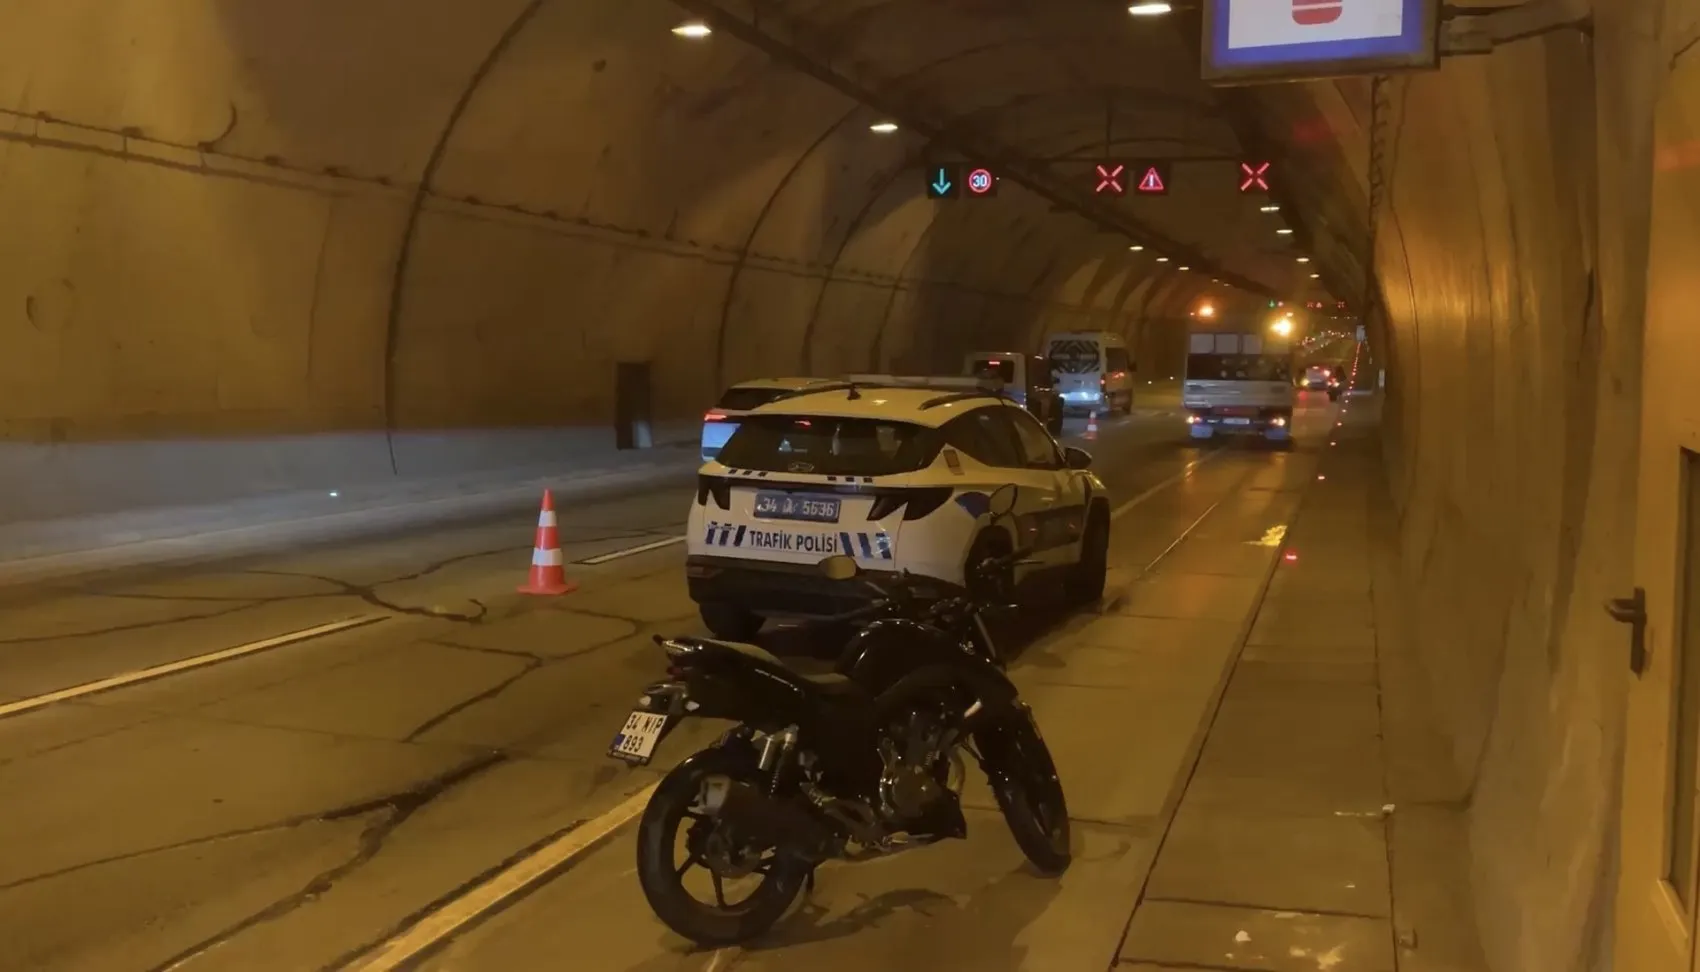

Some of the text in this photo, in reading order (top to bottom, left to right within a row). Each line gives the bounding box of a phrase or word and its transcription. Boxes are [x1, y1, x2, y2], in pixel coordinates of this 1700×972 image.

[973, 175, 987, 186] 30
[761, 497, 777, 513] 34
[749, 530, 838, 552] TRAFİK POLİSİ
[626, 714, 642, 730] 34
[623, 734, 644, 752] 893
